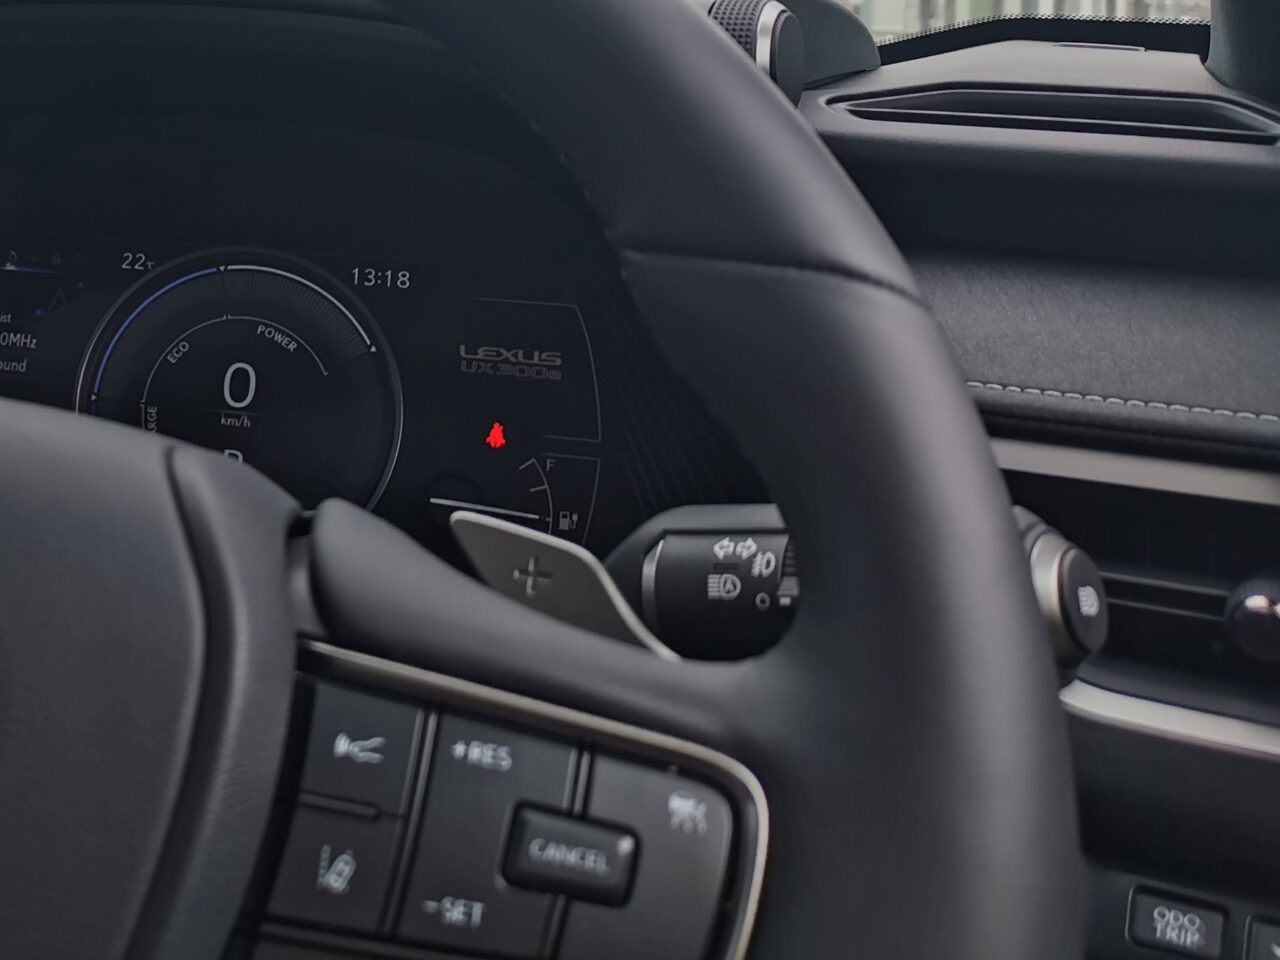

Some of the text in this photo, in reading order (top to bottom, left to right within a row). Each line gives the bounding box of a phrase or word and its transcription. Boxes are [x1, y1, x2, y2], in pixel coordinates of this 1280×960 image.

[350, 267, 411, 289] 13:18
[256, 324, 298, 354] POWER
[166, 340, 191, 365] ECO
[460, 344, 562, 366] LEXUS
[223, 362, 257, 409] 0
[220, 415, 252, 429] km/h
[546, 458, 557, 473] F
[528, 837, 609, 874] CANCEL
[1153, 906, 1202, 931] ODO
[1154, 922, 1203, 951] TRIP
